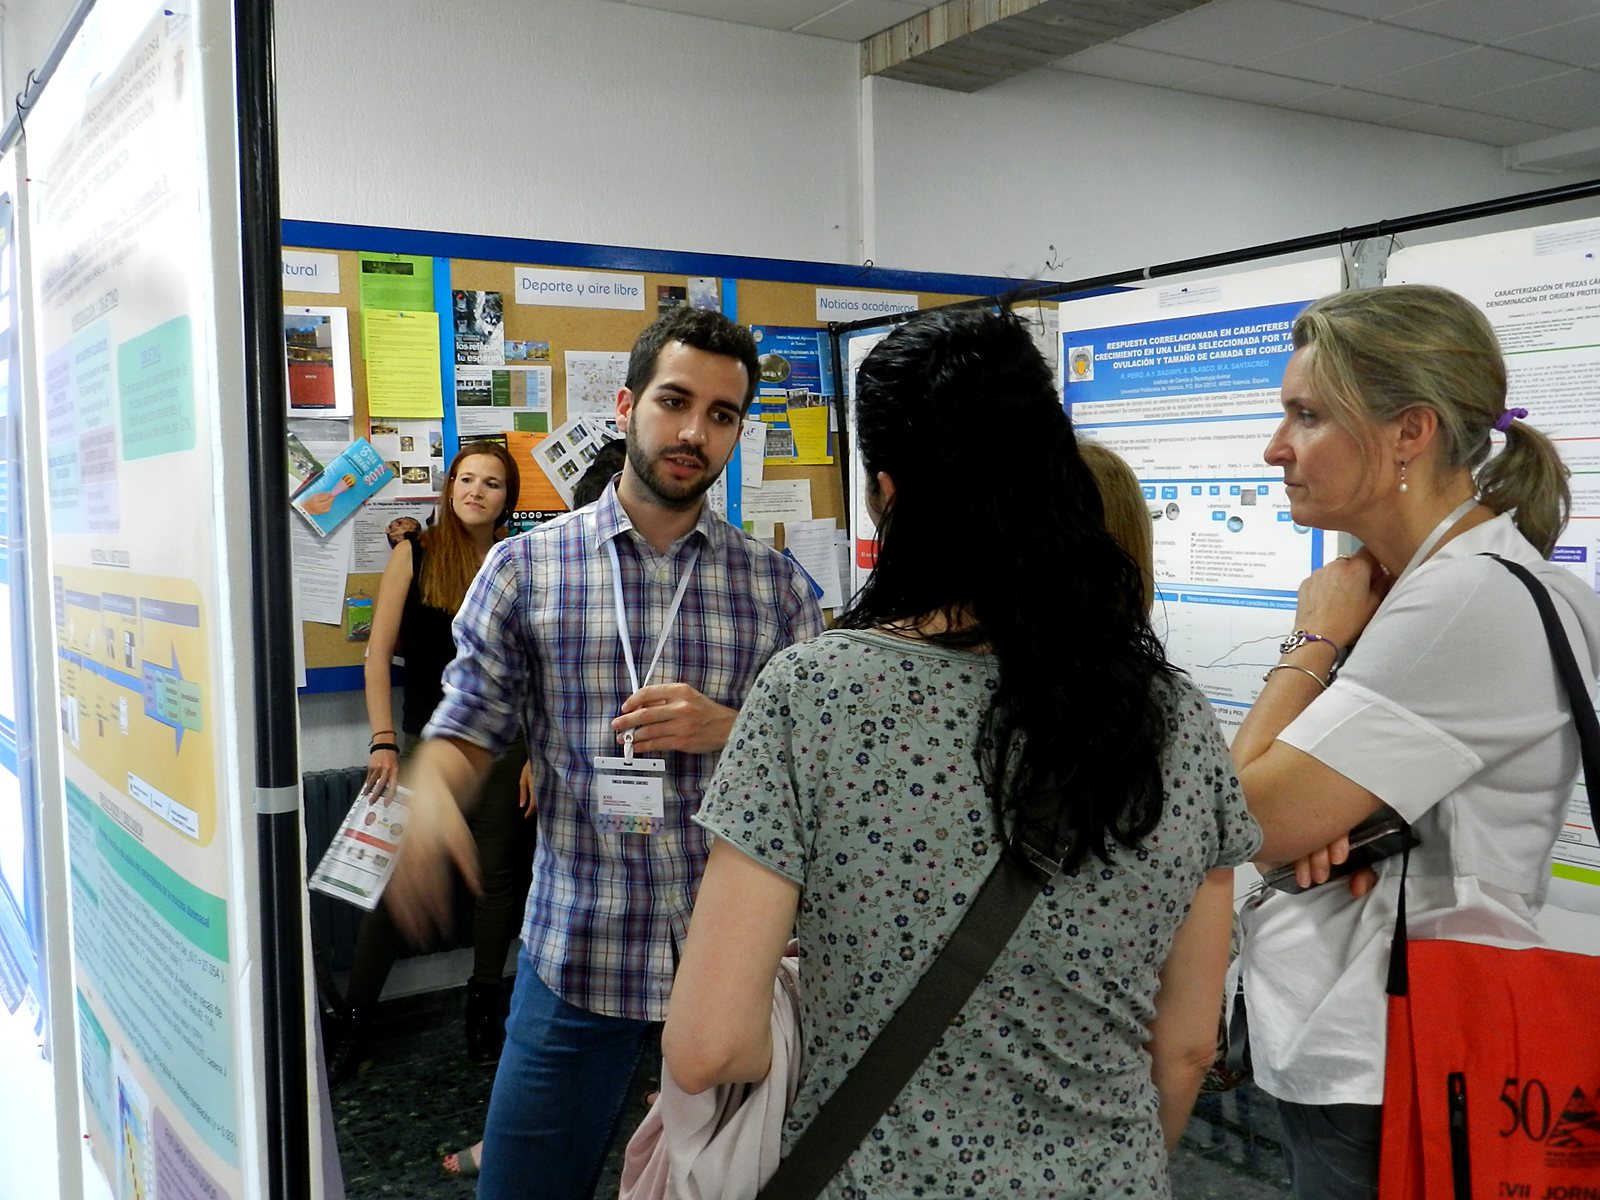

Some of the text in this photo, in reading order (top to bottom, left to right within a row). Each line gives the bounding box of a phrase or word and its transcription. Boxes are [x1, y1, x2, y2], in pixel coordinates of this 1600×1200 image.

[282, 262, 318, 276] tural
[522, 278, 638, 296] Deporte y aire libre
[1494, 284, 1553, 298] CARACTERIZACIÓN
[1554, 282, 1563, 290] DE
[1565, 279, 1588, 289] PIEZAS
[820, 298, 915, 313] Noticias académicos
[1486, 297, 1538, 309] DENOMINACIÓN
[1549, 292, 1575, 301] ORIGEN
[1106, 321, 1289, 350] RESPUESTA CORRELACIONADA EN CARACTERES
[1094, 332, 1293, 361] CRECIMIENTO EN UNA LÍNEA SELECCIONADA POR TA
[1113, 356, 1154, 369] OVULACIÓN
[1156, 357, 1162, 365] Y
[1163, 352, 1195, 364] TAMAÑO
[1197, 352, 1208, 361] DE
[1209, 349, 1243, 360] CAMADA
[1245, 347, 1256, 356] EN
[364, 463, 388, 486] 2017
[1499, 1077, 1550, 1142] 50
